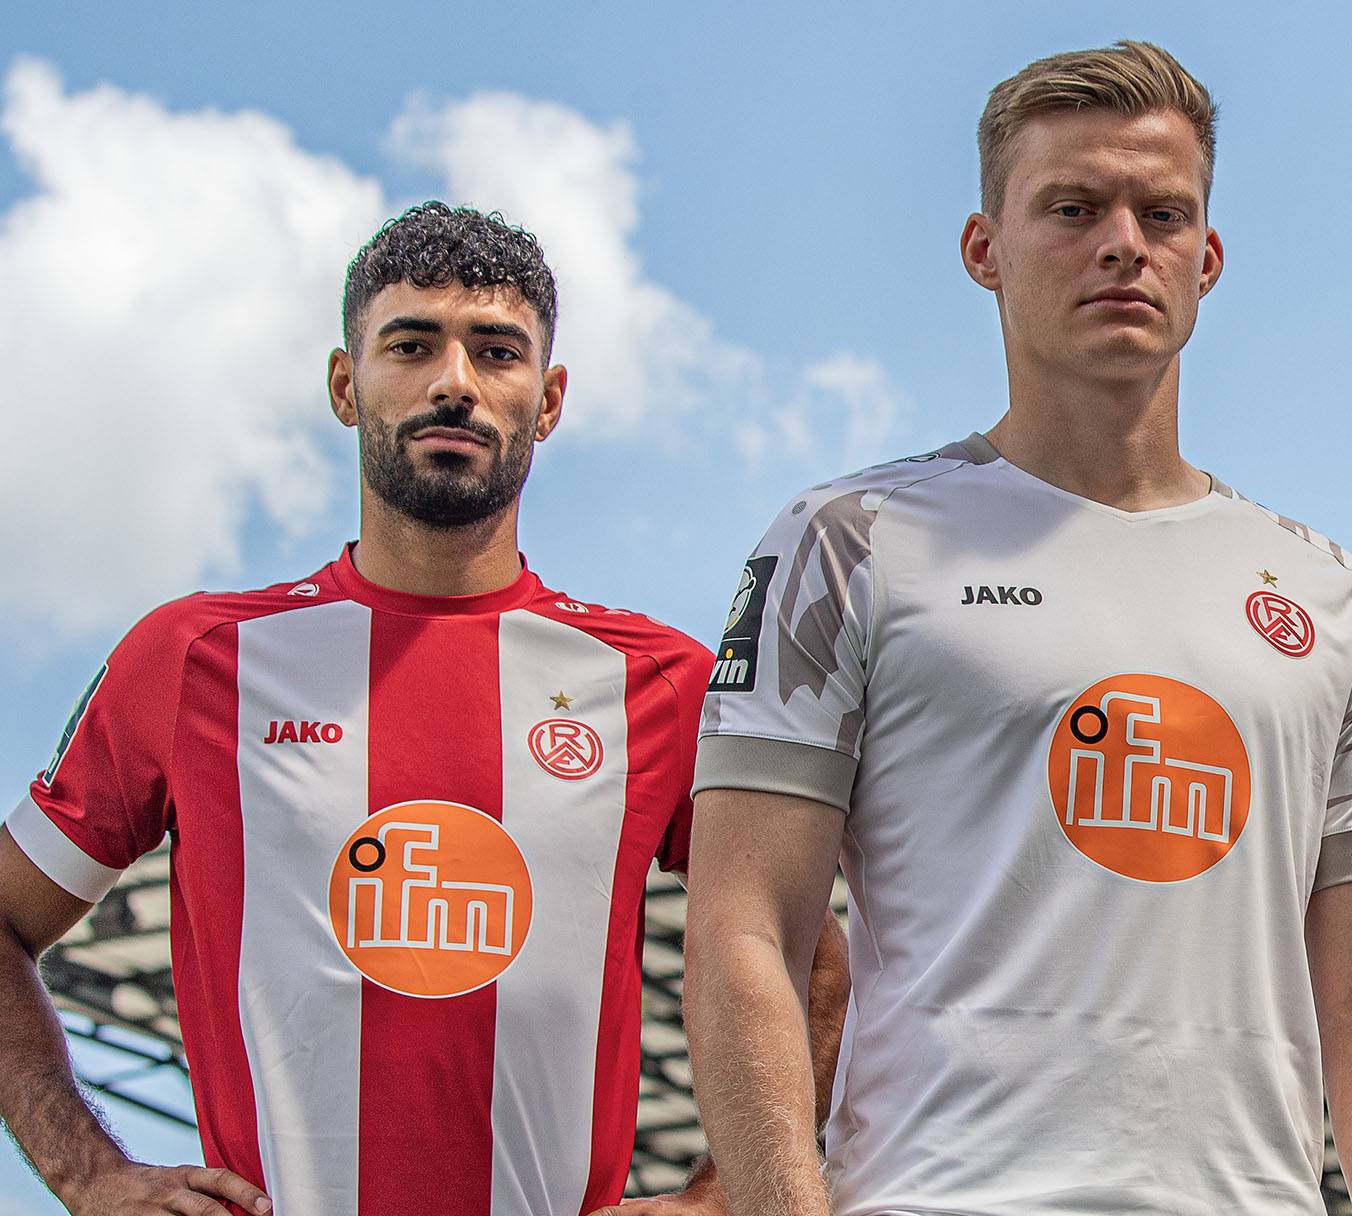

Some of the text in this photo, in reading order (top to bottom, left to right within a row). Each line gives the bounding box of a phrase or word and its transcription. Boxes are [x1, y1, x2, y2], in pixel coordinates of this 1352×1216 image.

[961, 586, 1042, 606] JAKO
[263, 720, 343, 744] JAKO
[1066, 691, 1232, 843] ifm
[347, 822, 514, 956] ifm
